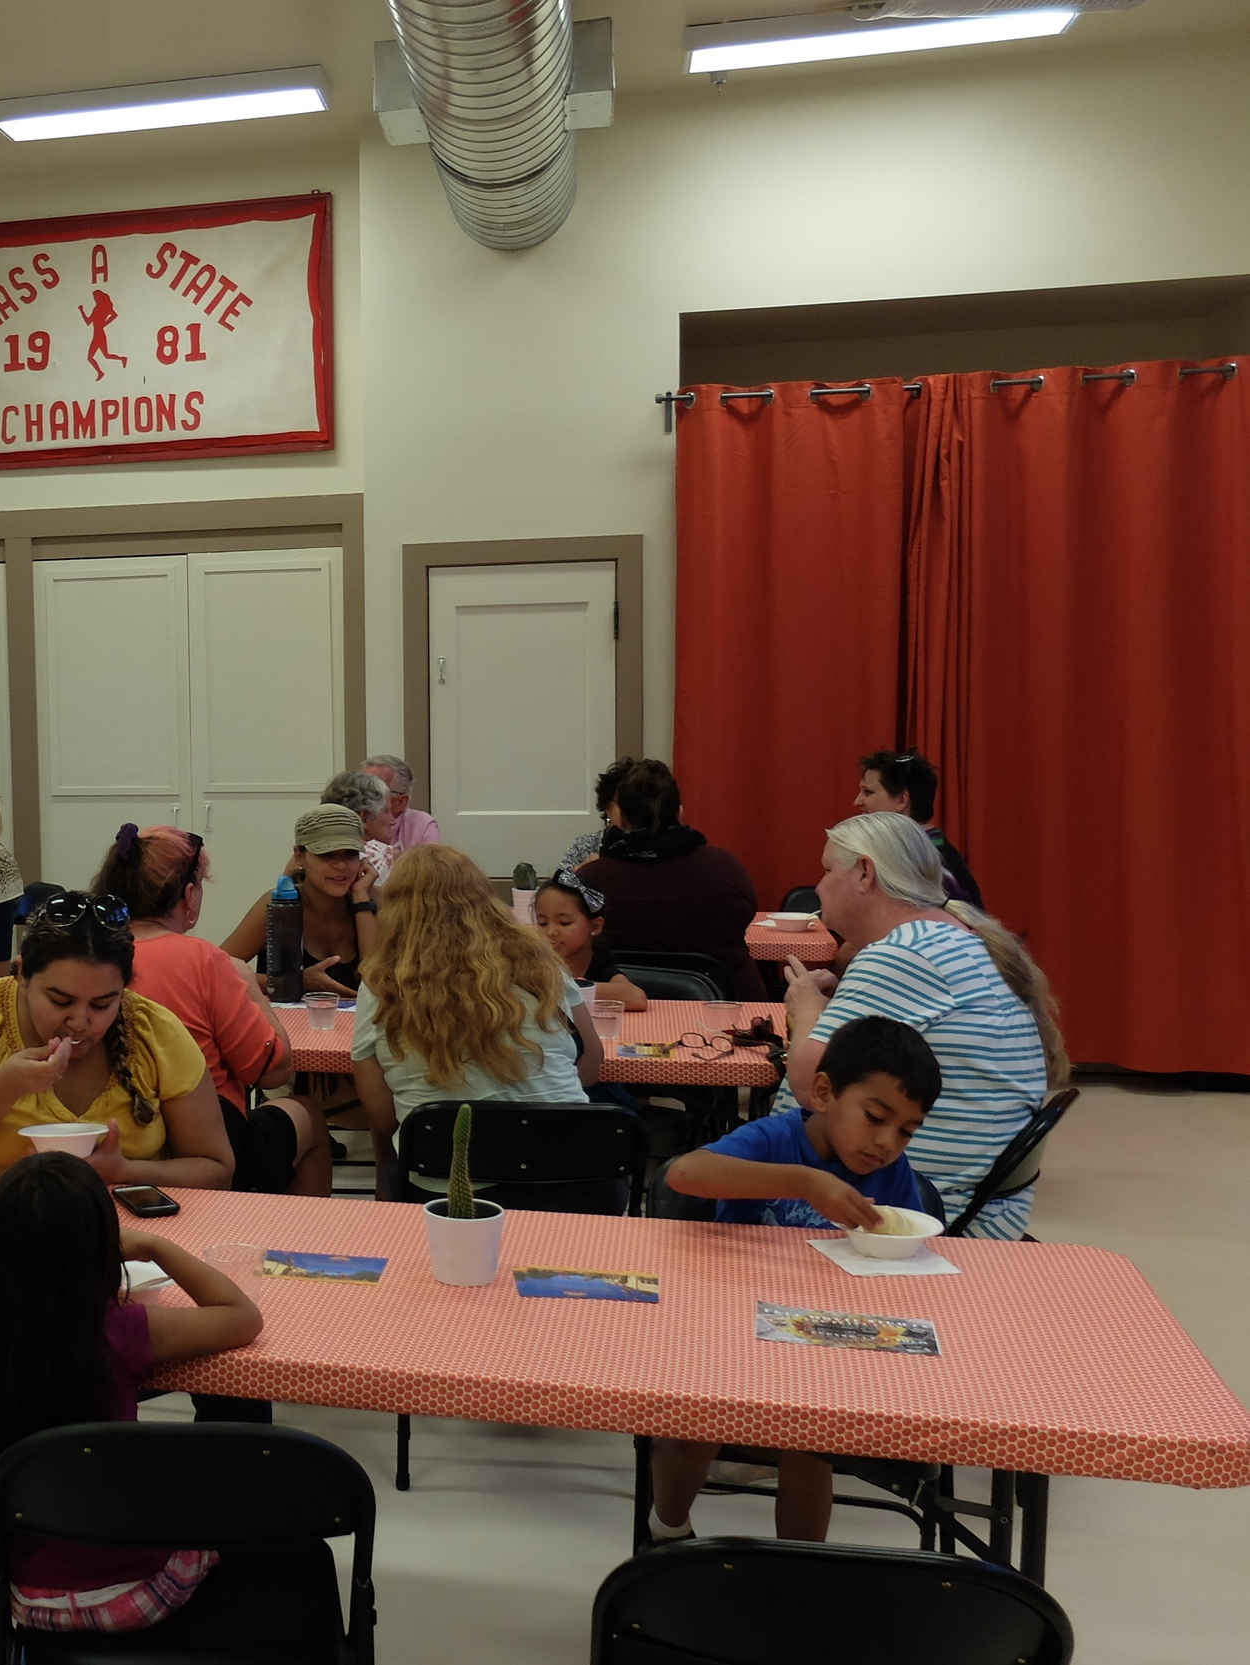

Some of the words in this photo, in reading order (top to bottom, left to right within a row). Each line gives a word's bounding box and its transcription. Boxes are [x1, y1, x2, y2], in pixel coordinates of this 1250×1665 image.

[91, 244, 109, 284] A
[145, 241, 254, 332] STATE
[3, 330, 51, 372] 19
[155, 322, 207, 365] 81
[0, 390, 205, 445] CHAMPIONS
